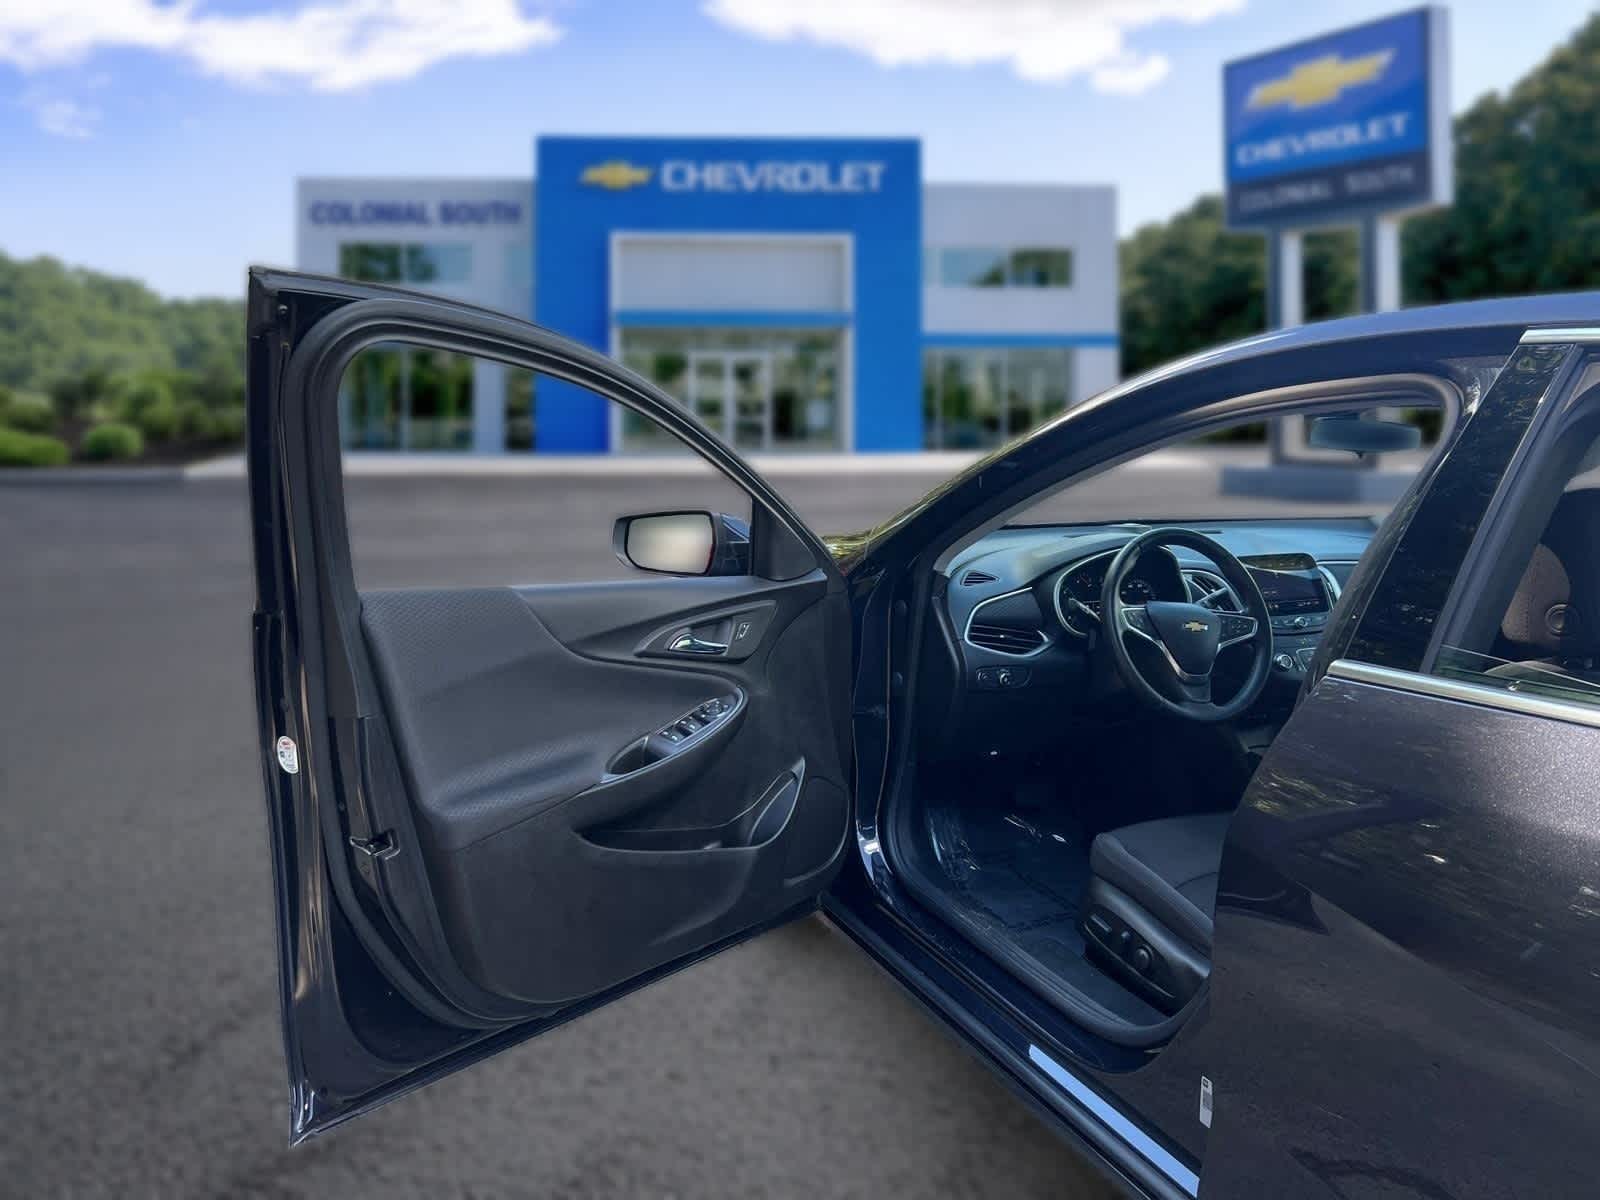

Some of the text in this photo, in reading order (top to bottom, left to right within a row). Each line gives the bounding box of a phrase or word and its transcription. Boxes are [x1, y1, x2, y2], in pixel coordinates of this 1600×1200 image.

[1236, 112, 1410, 167] CHEVROLET
[661, 160, 886, 193] CHEVROLET
[309, 200, 522, 227] COLONIAL SOUTH
